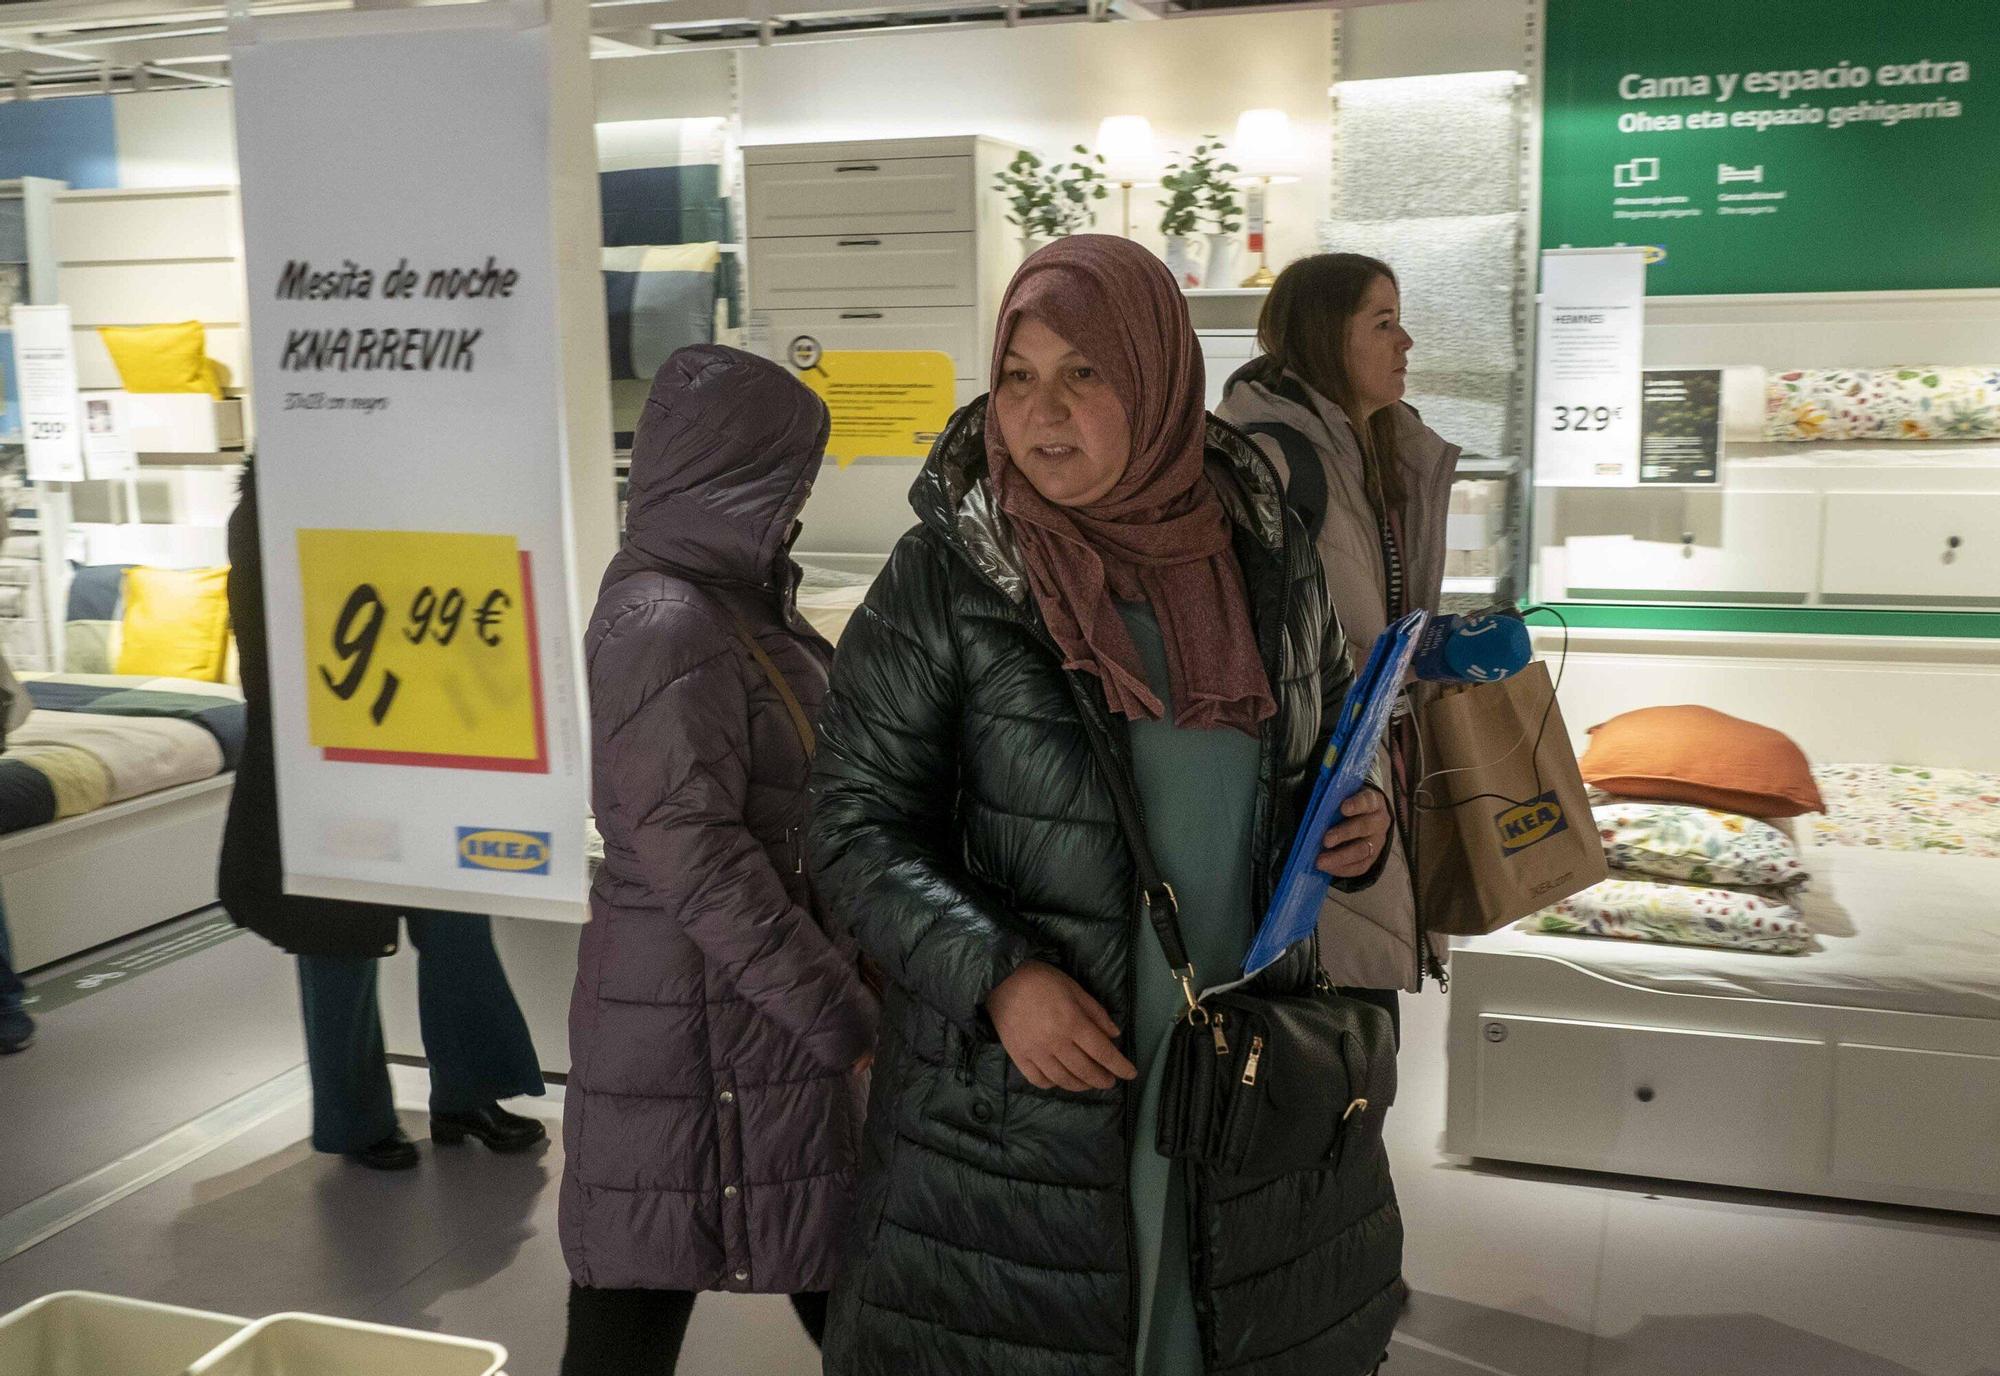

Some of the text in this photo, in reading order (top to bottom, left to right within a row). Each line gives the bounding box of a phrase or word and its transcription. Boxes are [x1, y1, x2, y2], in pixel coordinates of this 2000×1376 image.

[1618, 58, 1971, 103] Cama y espacio extra
[1618, 96, 1963, 134] Ohea eta espazio gehigarria
[276, 254, 518, 300] Mesita de noche
[280, 327, 484, 372] KNARREVIK
[468, 840, 542, 861] IKEA
